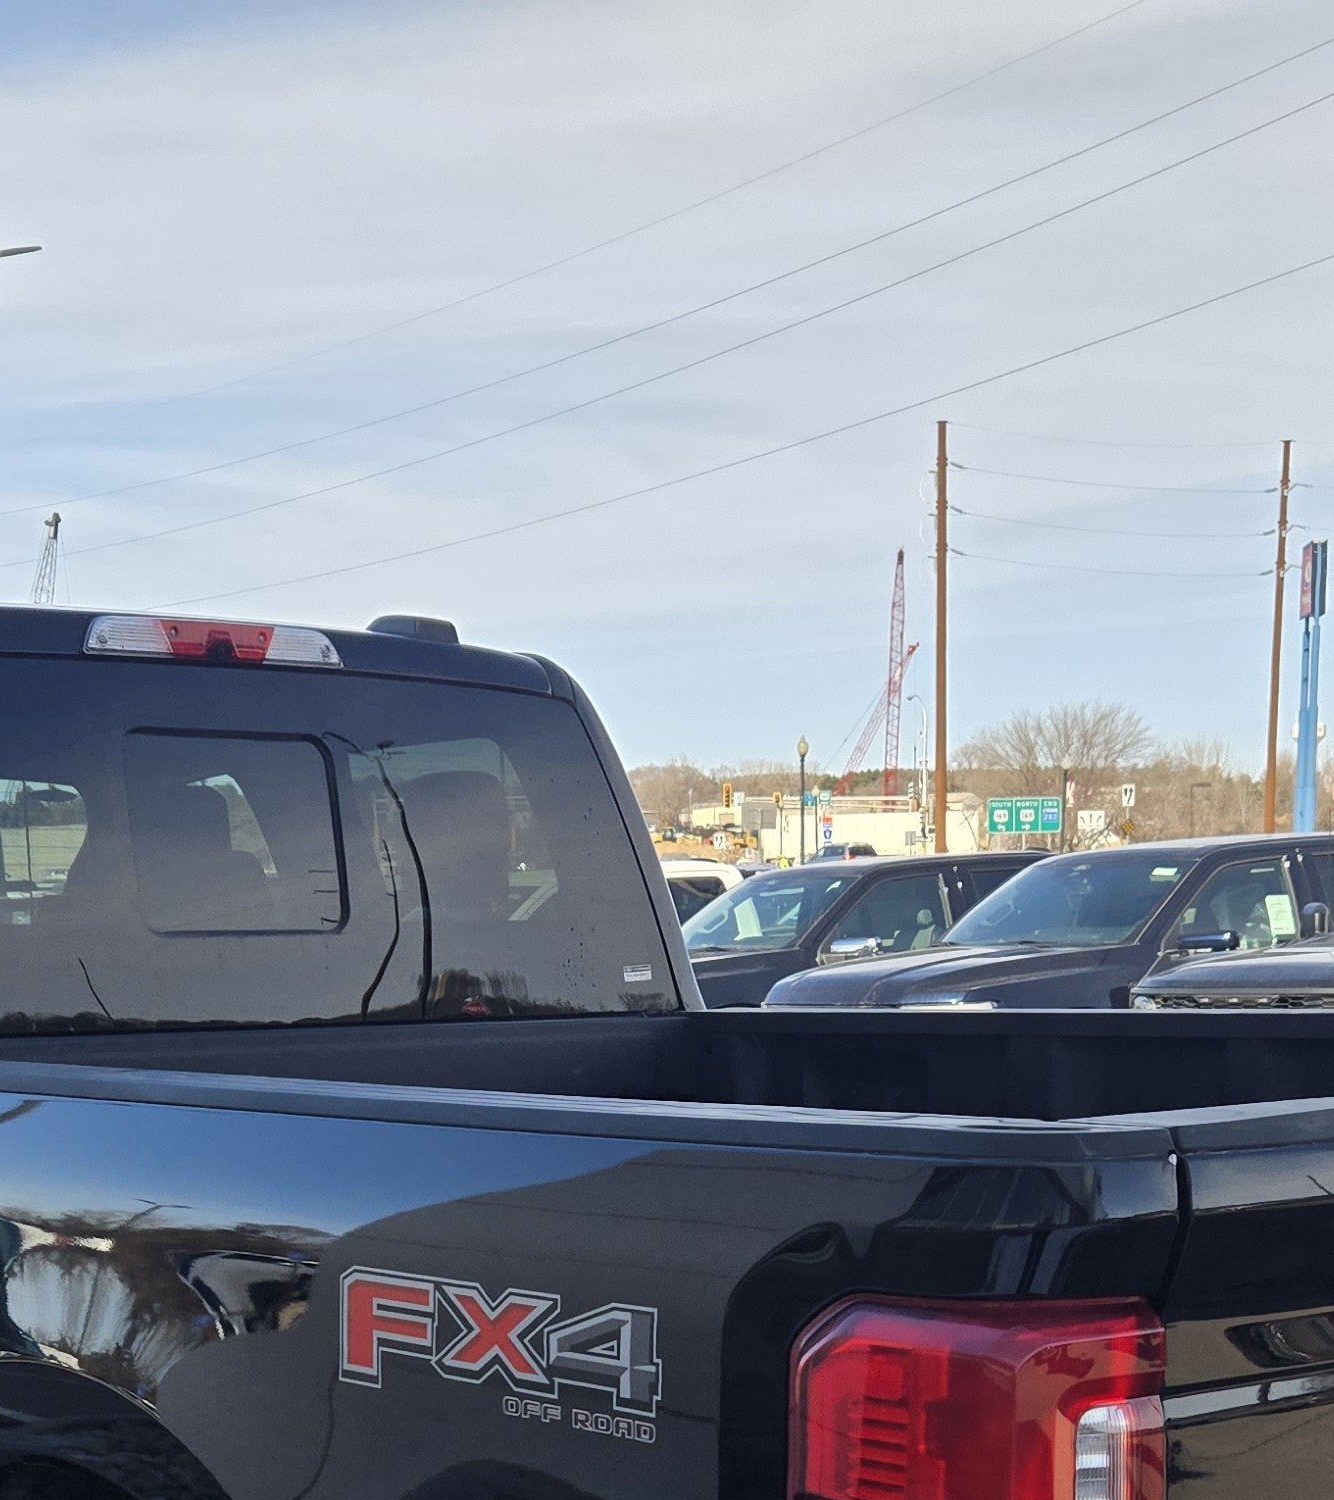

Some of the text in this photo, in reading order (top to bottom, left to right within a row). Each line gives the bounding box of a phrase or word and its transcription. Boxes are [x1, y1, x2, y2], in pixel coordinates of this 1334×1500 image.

[339, 1265, 662, 1418] FX4
[502, 1395, 656, 1443] OFF ROAD
